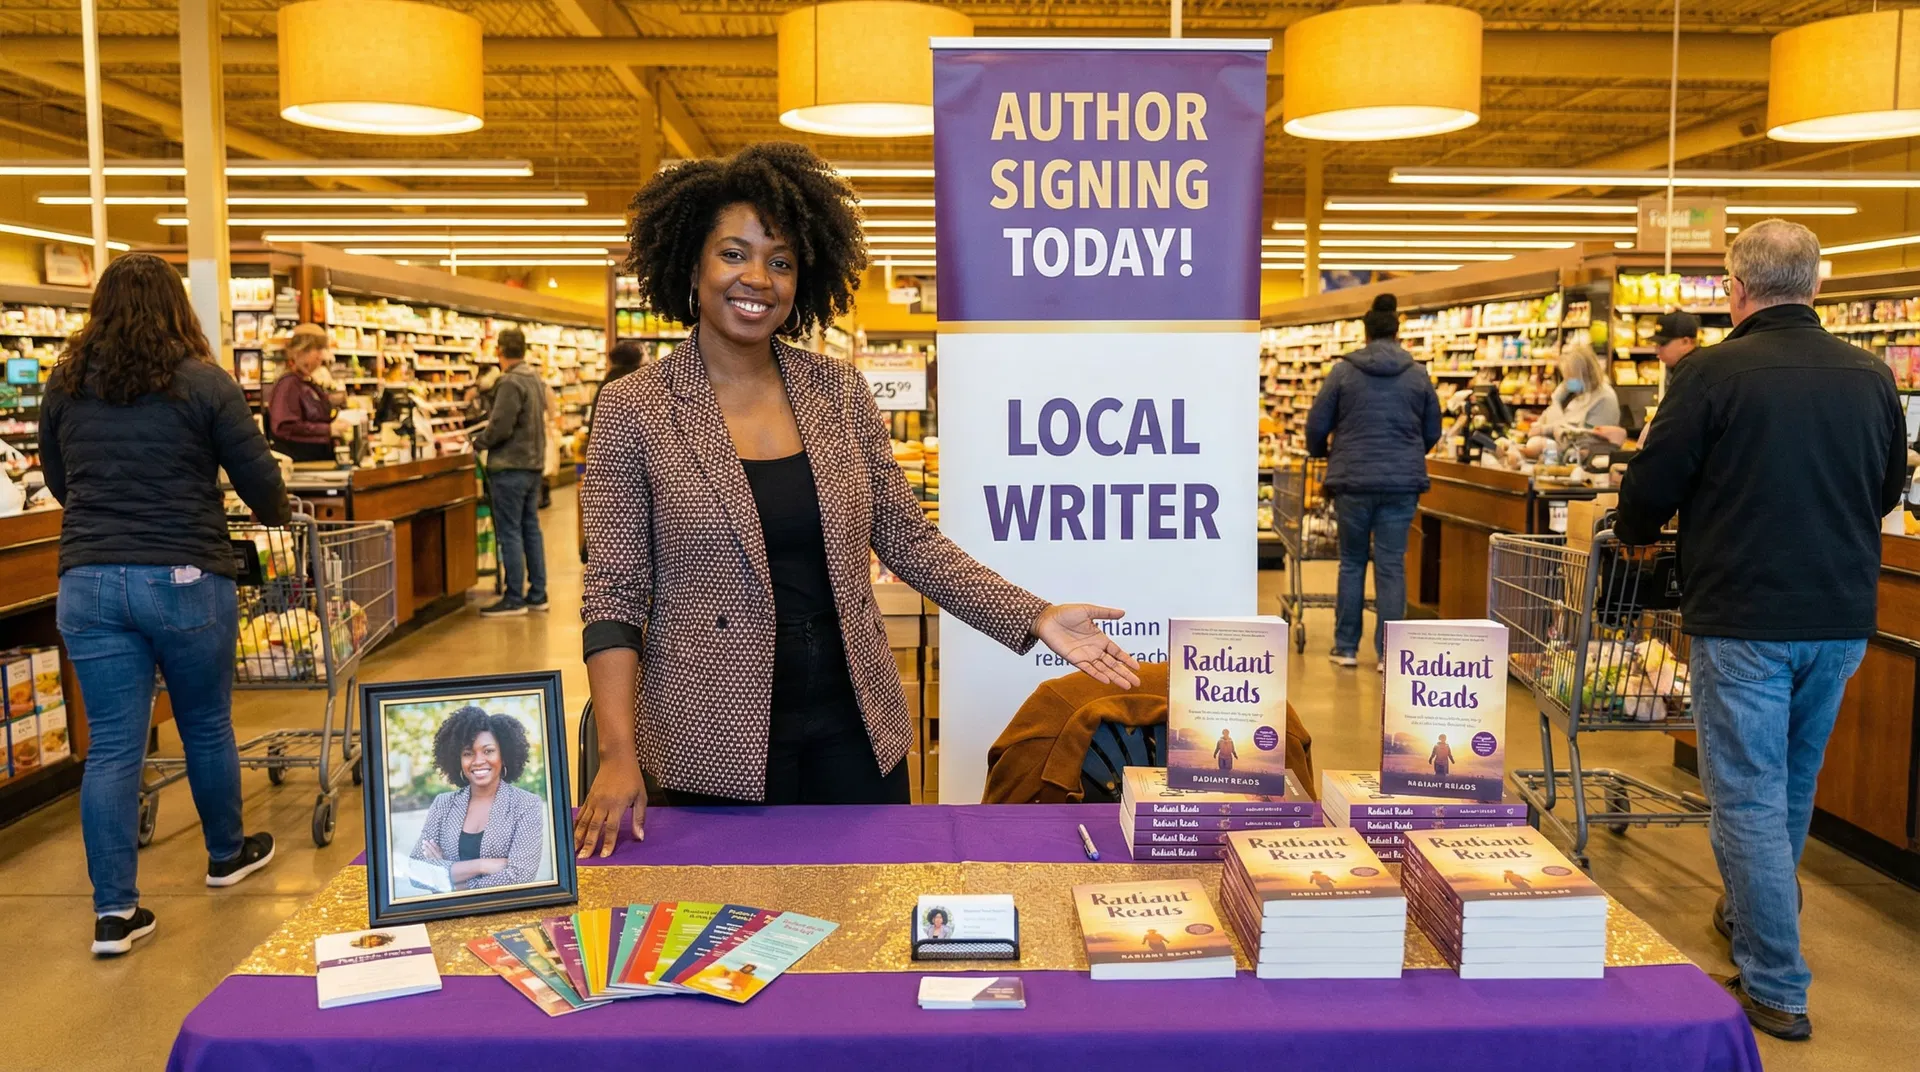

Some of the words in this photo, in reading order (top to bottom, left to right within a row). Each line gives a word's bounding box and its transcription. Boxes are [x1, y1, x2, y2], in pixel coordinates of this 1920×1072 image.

[990, 91, 1209, 142] AUTHOR
[989, 159, 1209, 210] SIGNING
[1003, 227, 1193, 277] TODAY!
[1008, 397, 1200, 456] LOCAL
[983, 483, 1222, 541] WRITER
[1183, 645, 1275, 675] Radiant
[1400, 650, 1494, 679] Radiant
[1195, 675, 1260, 704] Reads
[1411, 680, 1479, 709] Reads
[1248, 836, 1351, 849] Radiant
[1268, 849, 1347, 861] Reads
[1428, 835, 1534, 849] Radiant
[1452, 848, 1533, 860] Reads
[1090, 890, 1193, 906] Radiant
[1106, 904, 1184, 919] Reads
